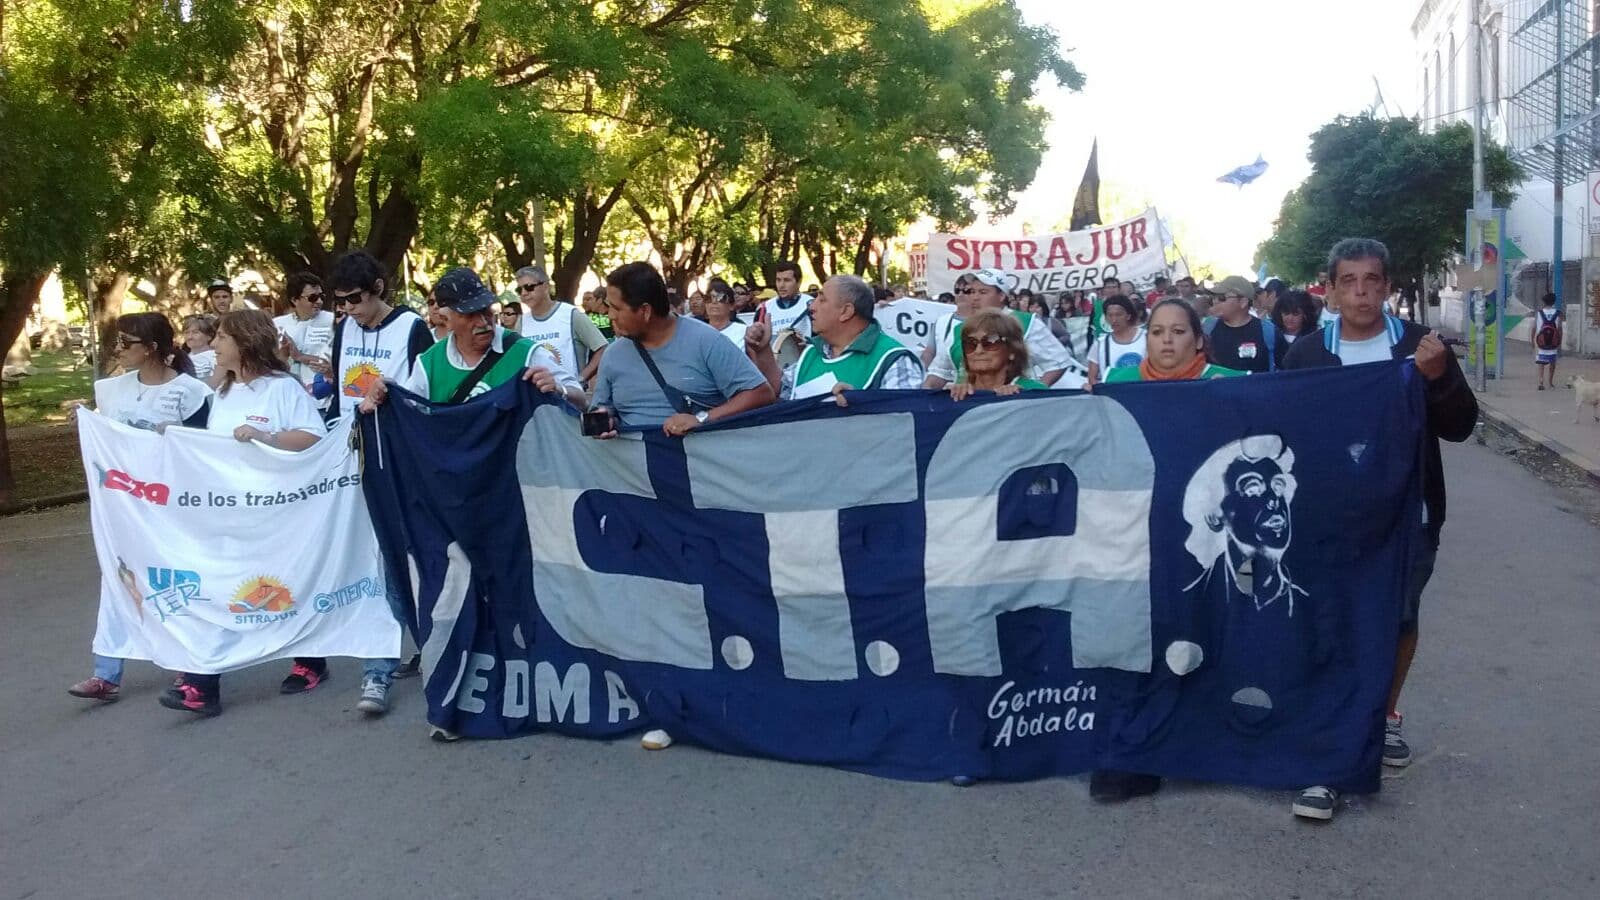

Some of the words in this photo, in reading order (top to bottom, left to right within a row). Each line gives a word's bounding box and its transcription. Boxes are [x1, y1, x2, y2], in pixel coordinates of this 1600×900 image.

[946, 217, 1149, 271] SITRAJUR
[1028, 264, 1119, 292] NEGRO
[178, 491, 201, 507] de
[208, 491, 237, 507] los
[235, 610, 298, 625] SITRAJUR
[987, 680, 1097, 719] Germán
[993, 706, 1096, 747] Abdala
